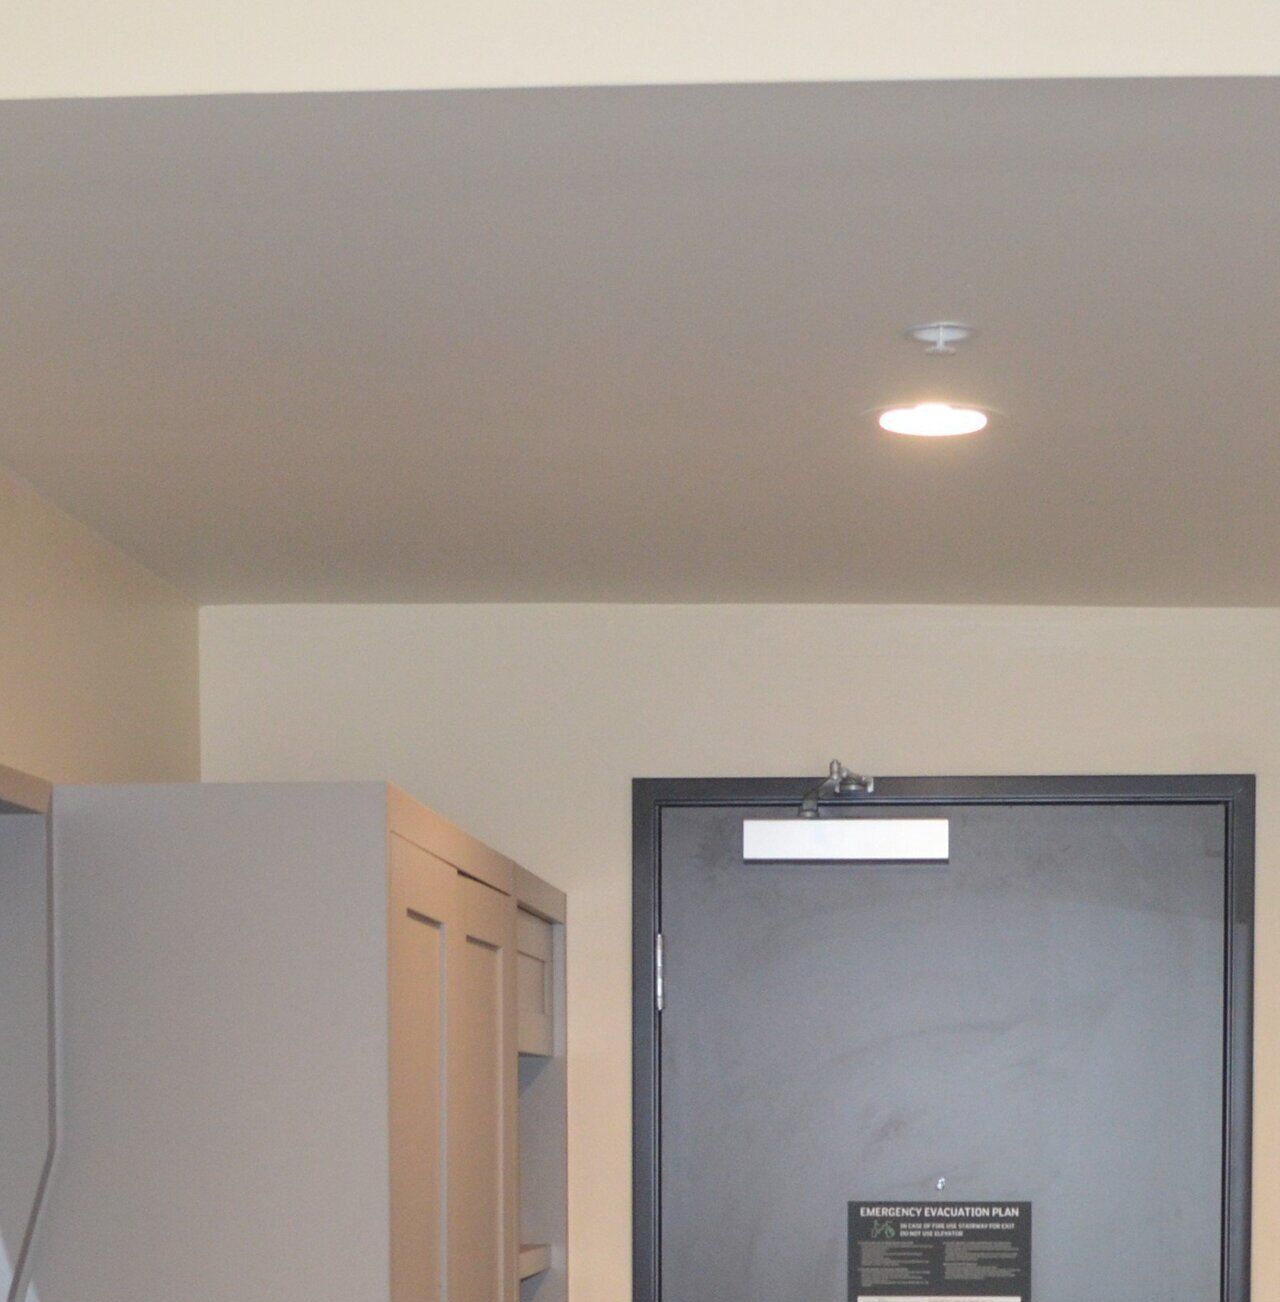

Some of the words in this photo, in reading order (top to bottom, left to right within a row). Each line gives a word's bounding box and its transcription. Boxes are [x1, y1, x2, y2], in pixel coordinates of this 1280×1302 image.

[860, 1207, 922, 1217] EMERGENCY
[924, 1207, 990, 1217] EVACUATION
[992, 1207, 1019, 1217] PLAN
